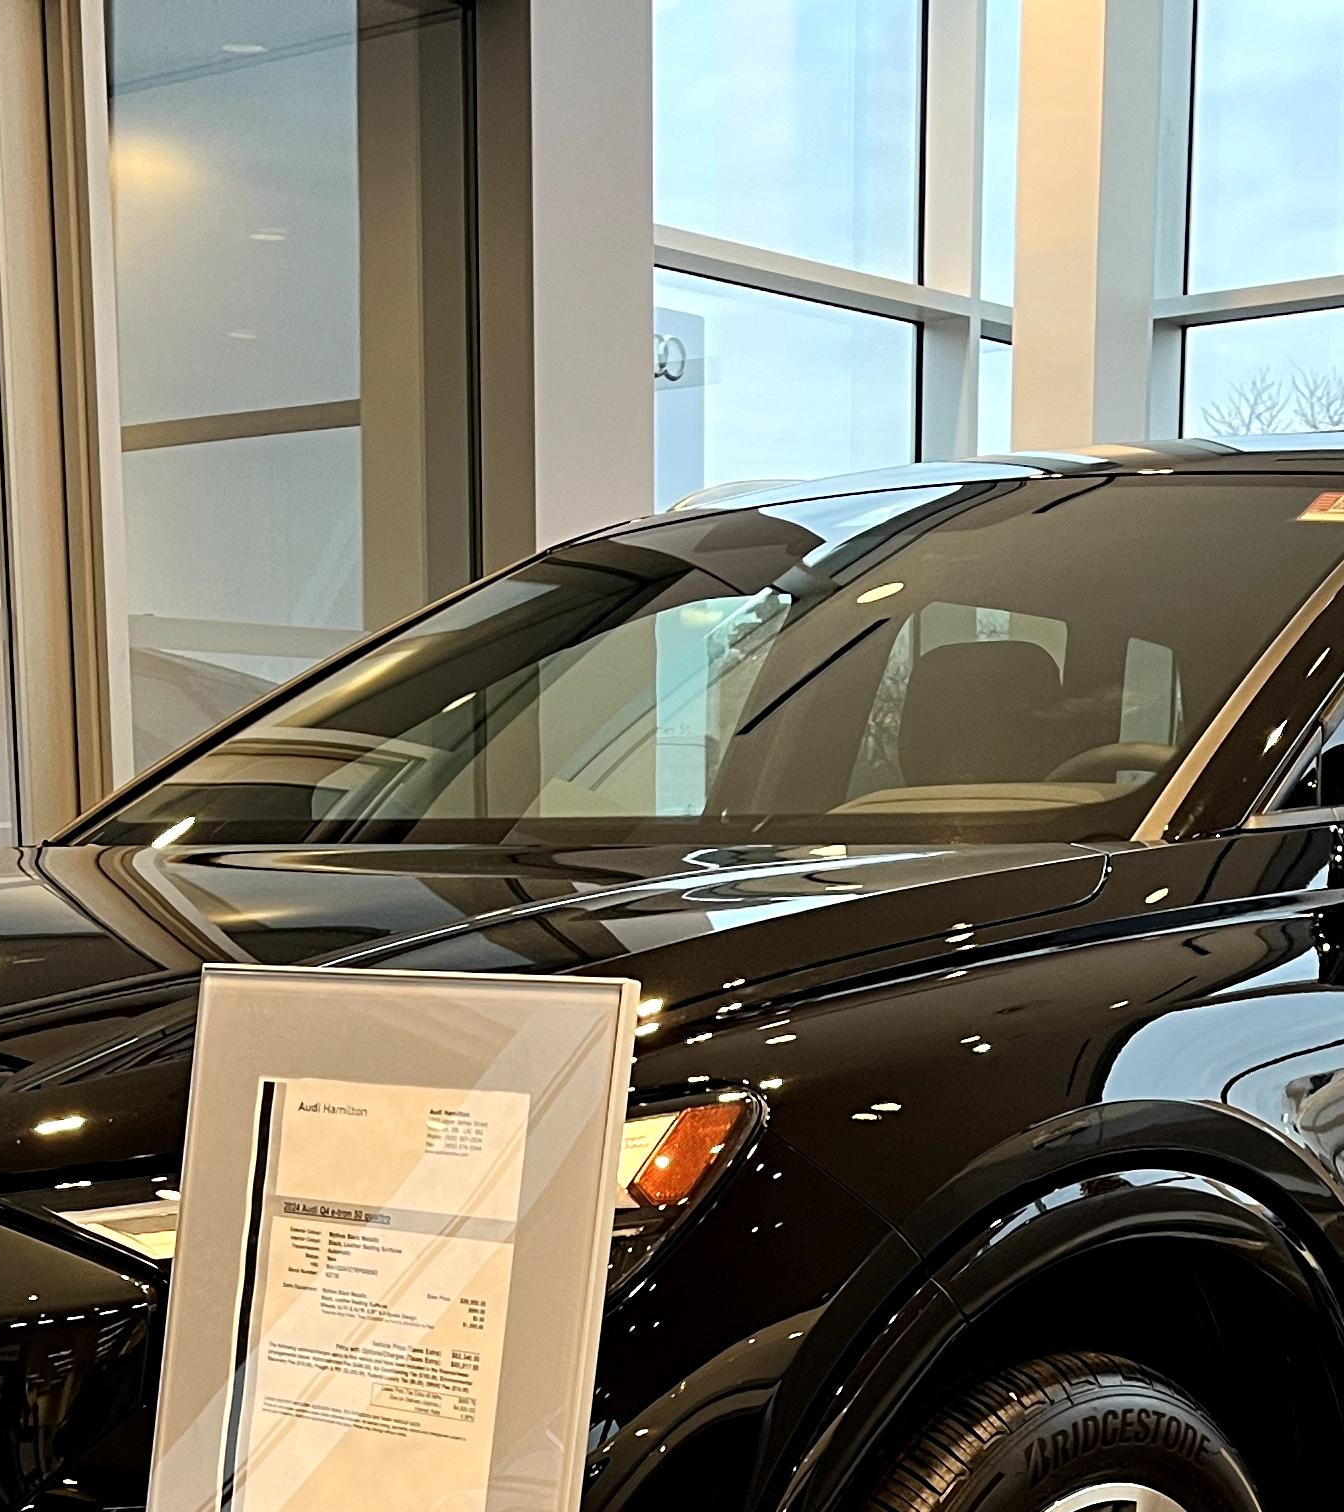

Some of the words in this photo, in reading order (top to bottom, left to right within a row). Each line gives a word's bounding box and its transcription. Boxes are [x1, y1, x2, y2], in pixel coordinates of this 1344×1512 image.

[298, 1101, 320, 1113] Audi
[323, 1103, 367, 1117] Hamilton
[1022, 1408, 1212, 1487] BRIDGESTONE
